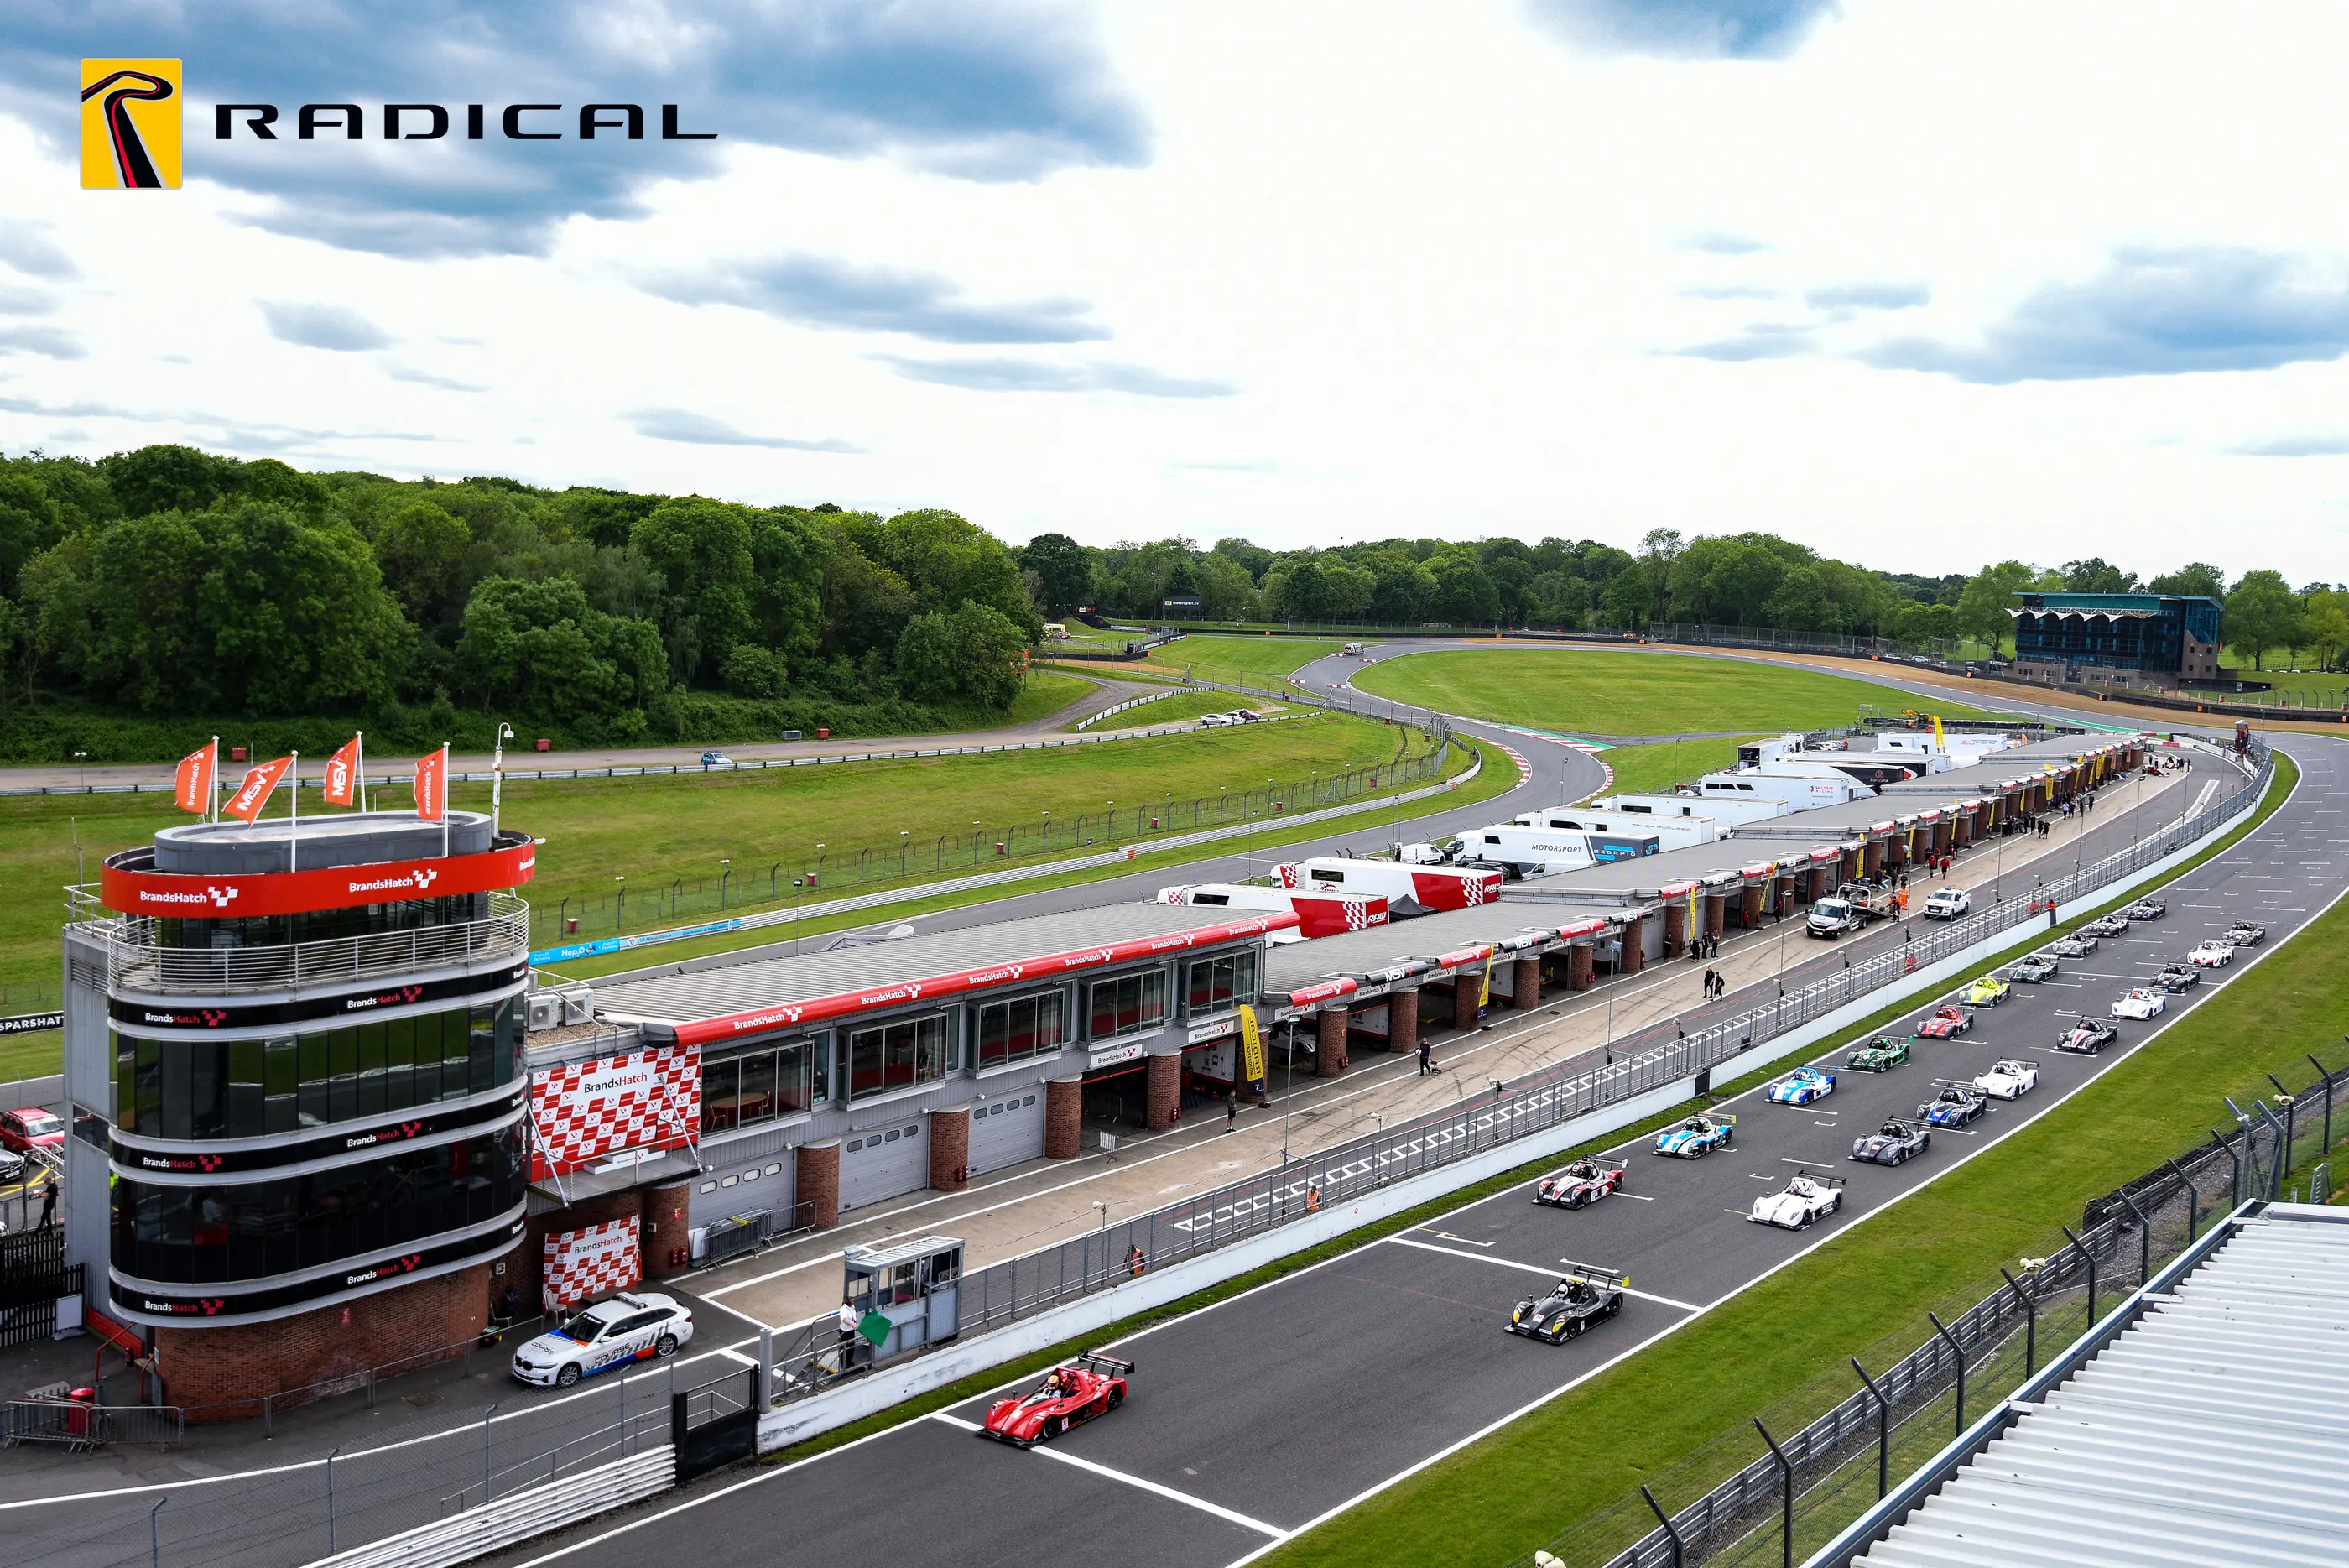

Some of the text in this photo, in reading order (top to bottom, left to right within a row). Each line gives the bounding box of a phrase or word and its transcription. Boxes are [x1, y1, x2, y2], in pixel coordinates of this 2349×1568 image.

[187, 763, 201, 806] BrandsHatch
[332, 761, 348, 796] MSV
[237, 773, 265, 812] MSV
[1531, 844, 1582, 853] MOTORSPORT
[349, 877, 414, 893] BrandsHatch
[1484, 883, 1501, 893] RAW
[139, 890, 207, 904] BrandsHatch
[1367, 911, 1387, 924] RAW
[1228, 924, 1258, 935] BrandsHatch
[1151, 937, 1184, 951] BrandsHatch
[1515, 938, 1533, 949] MSV
[1065, 952, 1102, 966] BrandsHatch
[968, 970, 1009, 985] BrandsHatch
[1383, 967, 1406, 982] MSV
[347, 992, 401, 1009] BrandsHatch
[861, 989, 906, 1005] BrandsHatch
[144, 1012, 200, 1024] BrandsHatch
[733, 1013, 785, 1030] BrandsHatch
[1195, 1028, 1221, 1039] BrandsHatch
[1097, 1051, 1127, 1064] BrandsHatch
[584, 1072, 648, 1093] BrandsHatch
[347, 1129, 400, 1148] BrandsHatch
[143, 1156, 196, 1169] BrandsHatch
[574, 1235, 622, 1254] BrandsHatch
[347, 1263, 400, 1284] BrandsHatch
[144, 1300, 198, 1313] BrandsHatch
[530, 1342, 555, 1355] COURSE
[595, 1343, 631, 1365] COURSE
